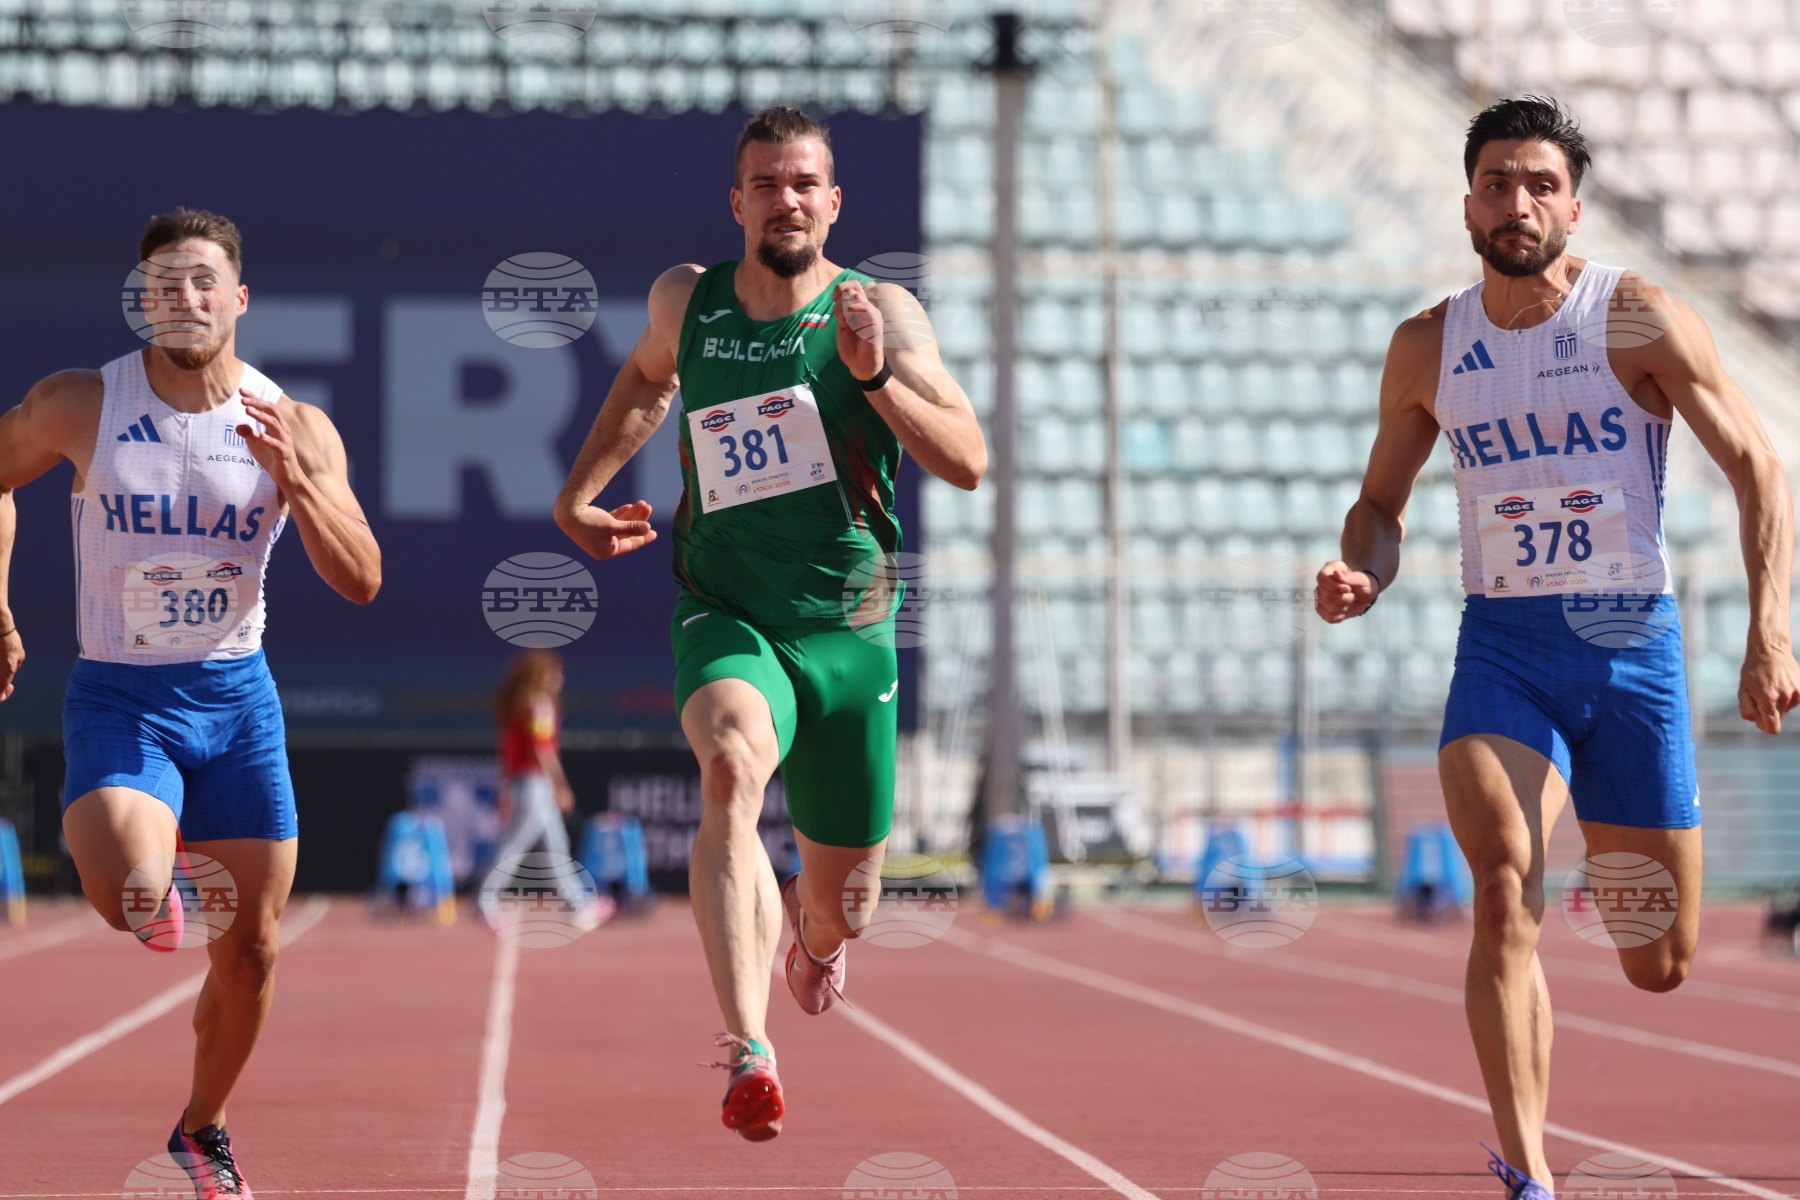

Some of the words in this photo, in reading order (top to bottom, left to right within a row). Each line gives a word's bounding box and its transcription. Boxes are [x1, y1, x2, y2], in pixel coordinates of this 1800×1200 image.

[1536, 364, 1588, 379] AEGEAN
[206, 454, 255, 467] AEGEAN
[719, 424, 789, 477] 381
[1445, 406, 1627, 469] HELLAS
[99, 494, 265, 542] HELLAS
[1513, 519, 1592, 567] 378
[159, 587, 229, 628] 380
